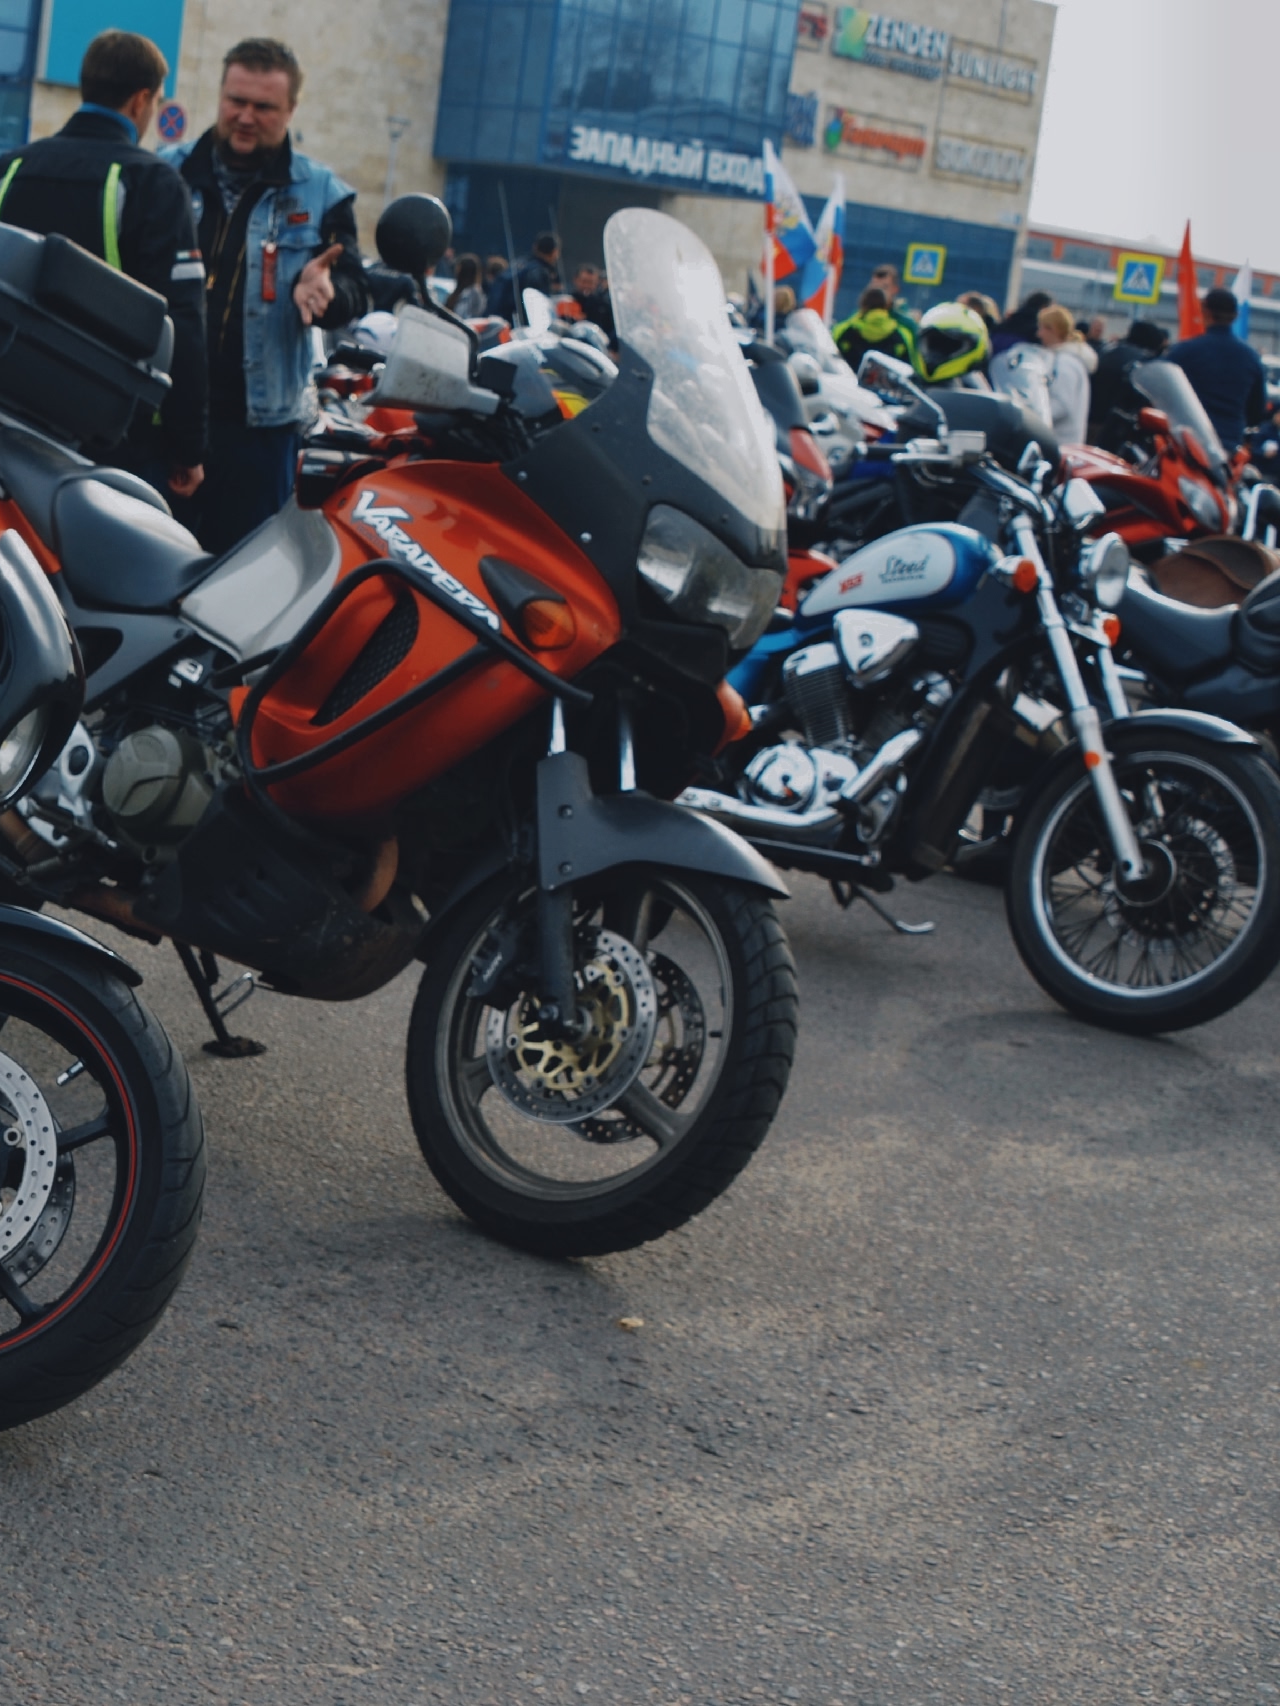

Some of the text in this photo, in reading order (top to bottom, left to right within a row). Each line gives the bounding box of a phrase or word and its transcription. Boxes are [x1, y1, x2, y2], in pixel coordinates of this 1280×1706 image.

[865, 13, 947, 61] ZENDEN
[949, 50, 1037, 93] SUNLIGHT
[570, 125, 765, 195] ЗАПАДНЫЙ ВХОД
